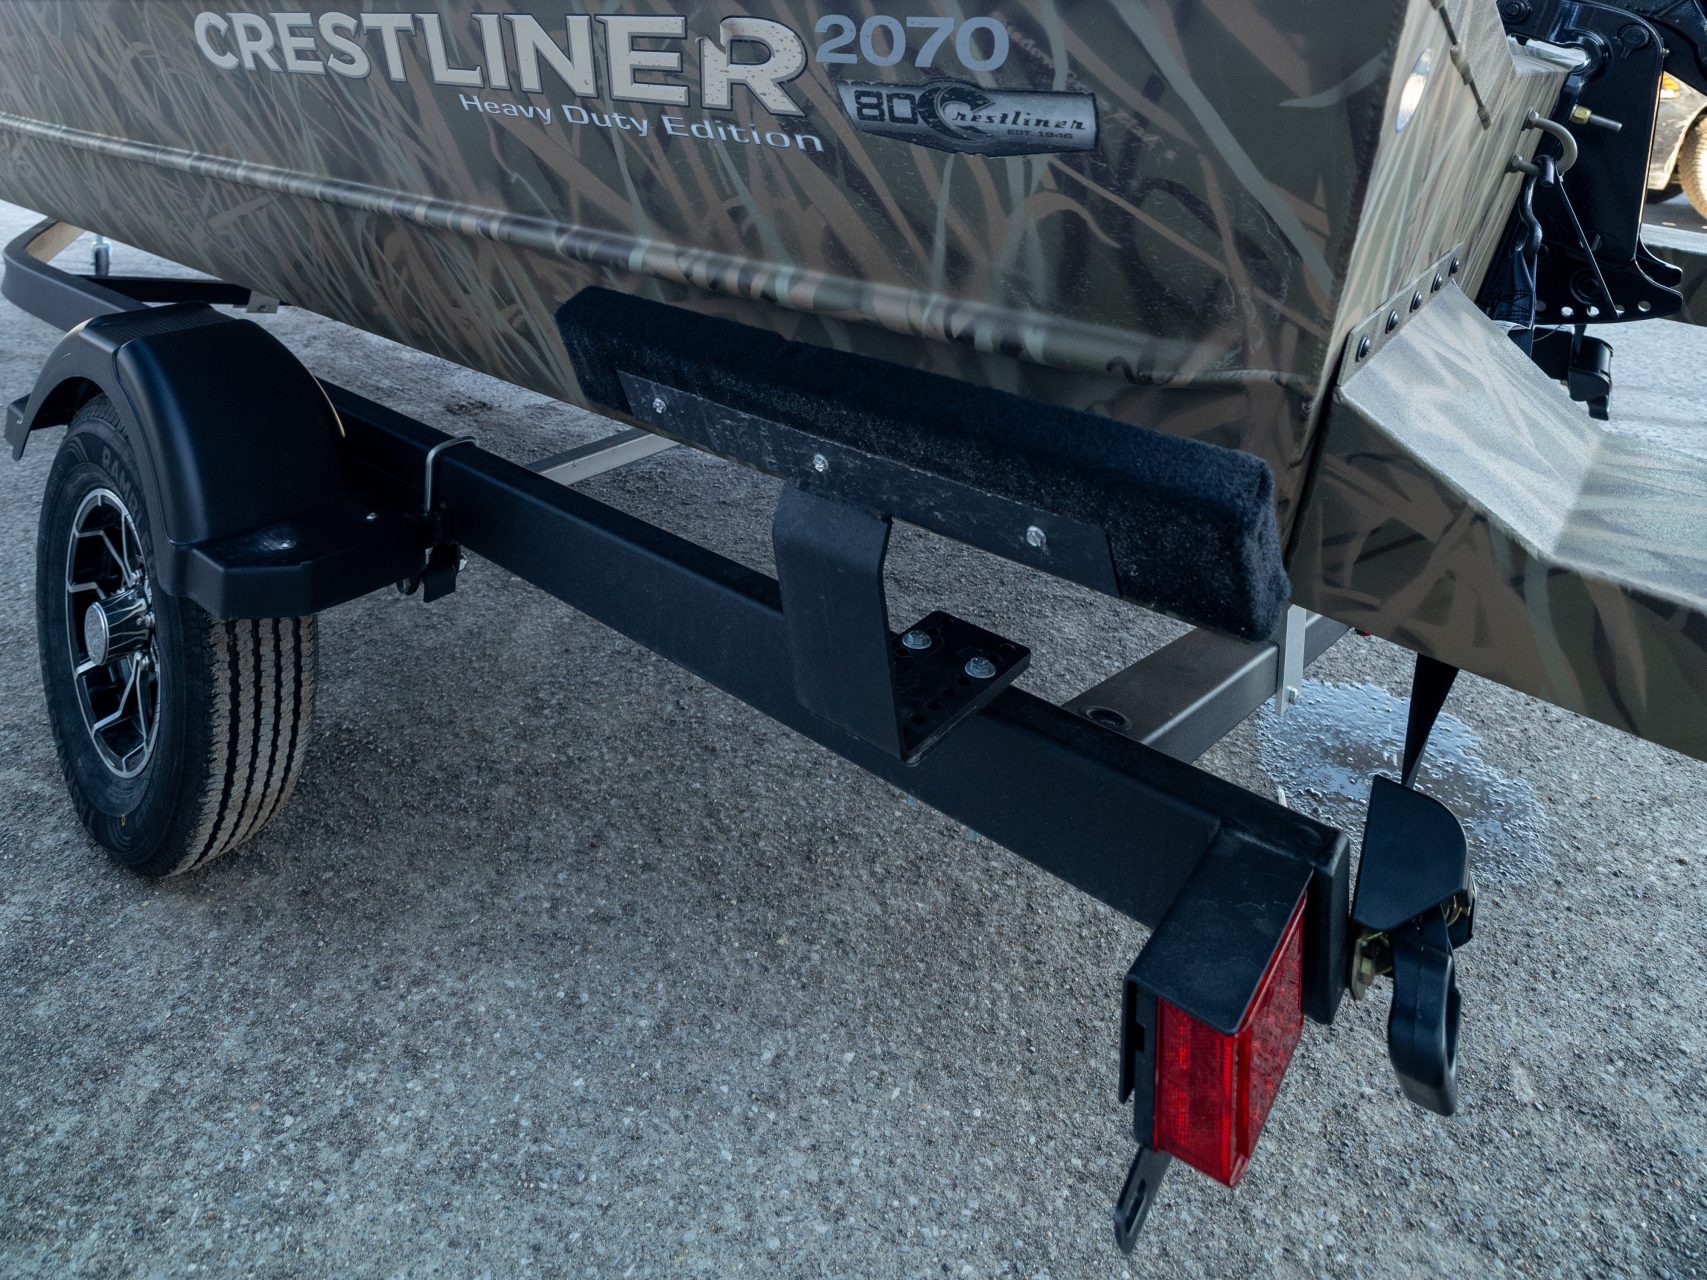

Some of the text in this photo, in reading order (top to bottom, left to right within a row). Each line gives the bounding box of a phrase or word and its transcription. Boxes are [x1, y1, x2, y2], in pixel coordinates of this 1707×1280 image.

[193, 11, 808, 117] CRESTLINER
[814, 14, 1010, 71] 2070
[458, 93, 824, 152] Heavy Duty Edition
[854, 89, 918, 125] 80
